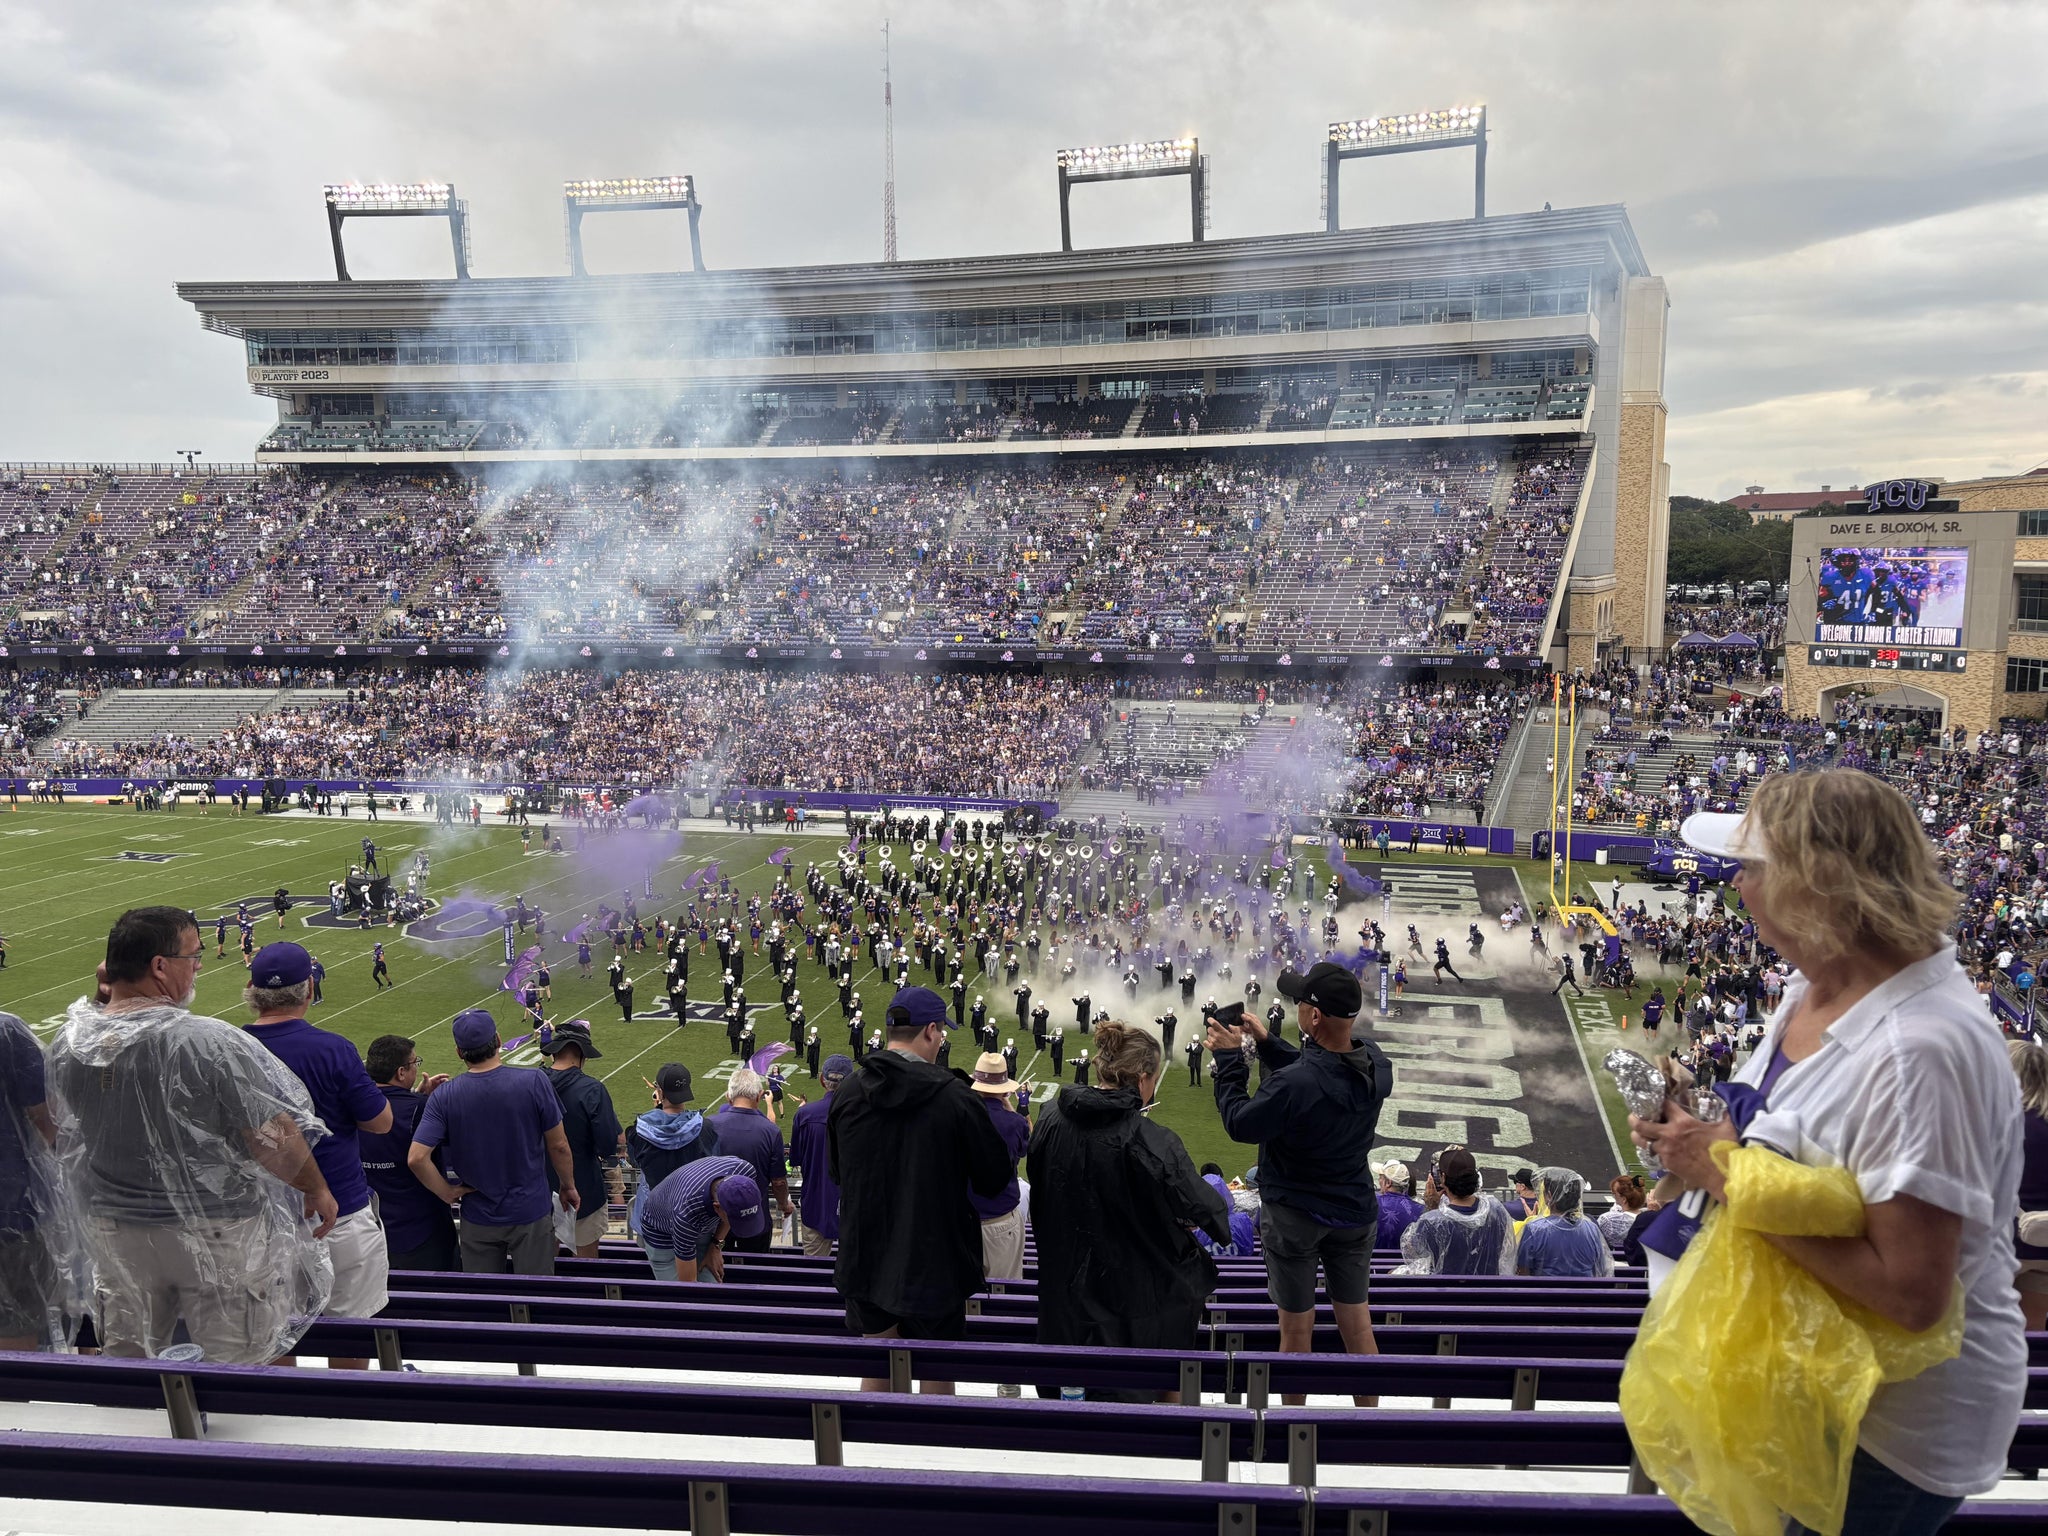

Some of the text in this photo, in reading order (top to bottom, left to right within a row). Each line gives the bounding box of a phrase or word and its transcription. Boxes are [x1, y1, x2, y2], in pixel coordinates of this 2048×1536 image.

[262, 370, 329, 381] PLAYOFF 2023
[1864, 480, 1929, 512] TCU
[1830, 521, 1963, 535] DAVE E. BLOXOM, SR.
[1820, 624, 1853, 642] WELCOME
[1854, 625, 1862, 642] TO
[1864, 626, 1885, 643] AMON
[1895, 627, 1923, 644] CARTER
[1924, 627, 1957, 646] STADIUM
[1814, 650, 1822, 661] 0
[1824, 649, 1839, 658] TCU
[1877, 649, 1900, 661] 3:30
[1672, 858, 1698, 872] TCU
[1574, 1000, 1623, 1045] TEXAS
[740, 1205, 759, 1217] TCU
